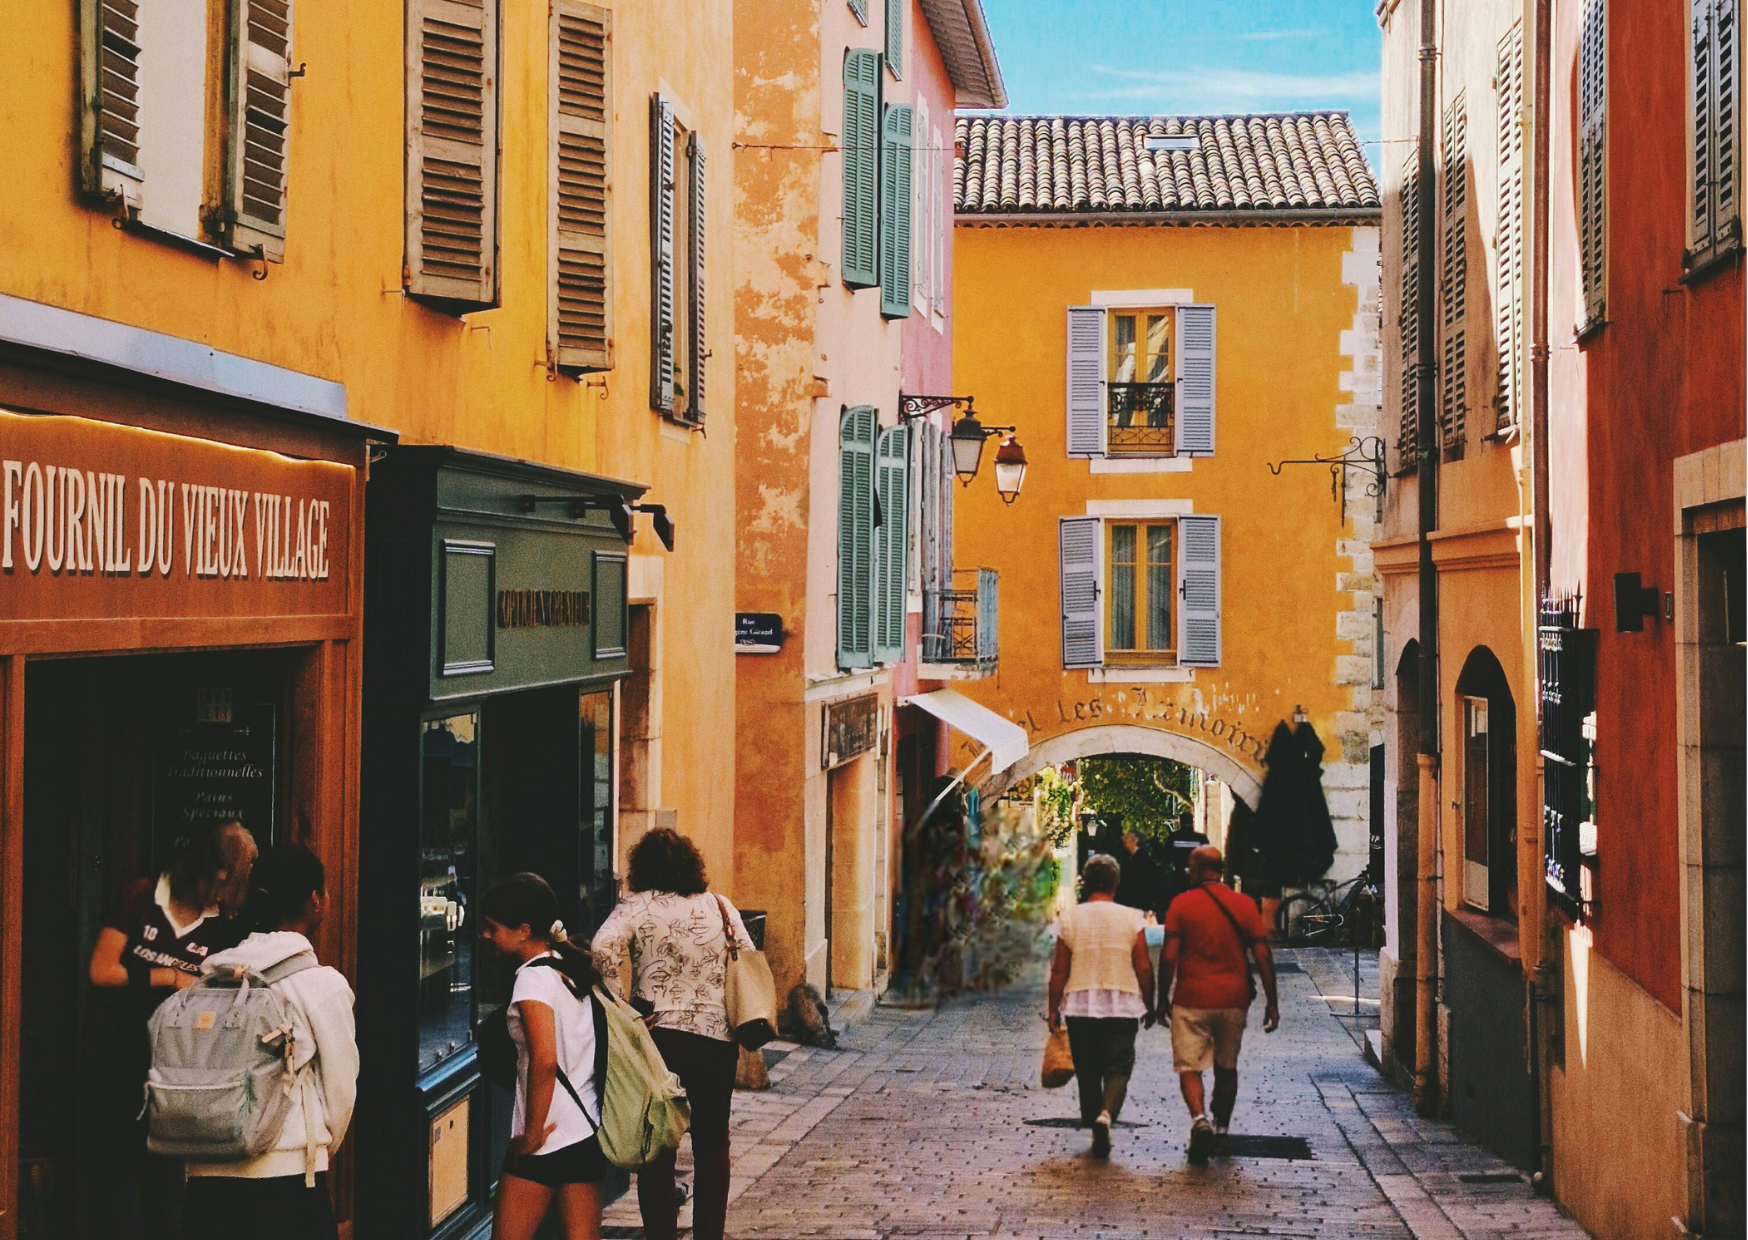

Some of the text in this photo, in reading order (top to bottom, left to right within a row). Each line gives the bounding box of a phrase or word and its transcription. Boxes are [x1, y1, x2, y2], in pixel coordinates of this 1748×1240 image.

[2, 460, 330, 579] FOURNIL DU VIEUX VILLAGE
[1057, 698, 1102, 724] les
[182, 747, 247, 764] Baguettes
[165, 763, 264, 779] Traditionnelles
[195, 790, 234, 803] Pains
[143, 924, 158, 941] 10
[133, 945, 157, 962] LOS
